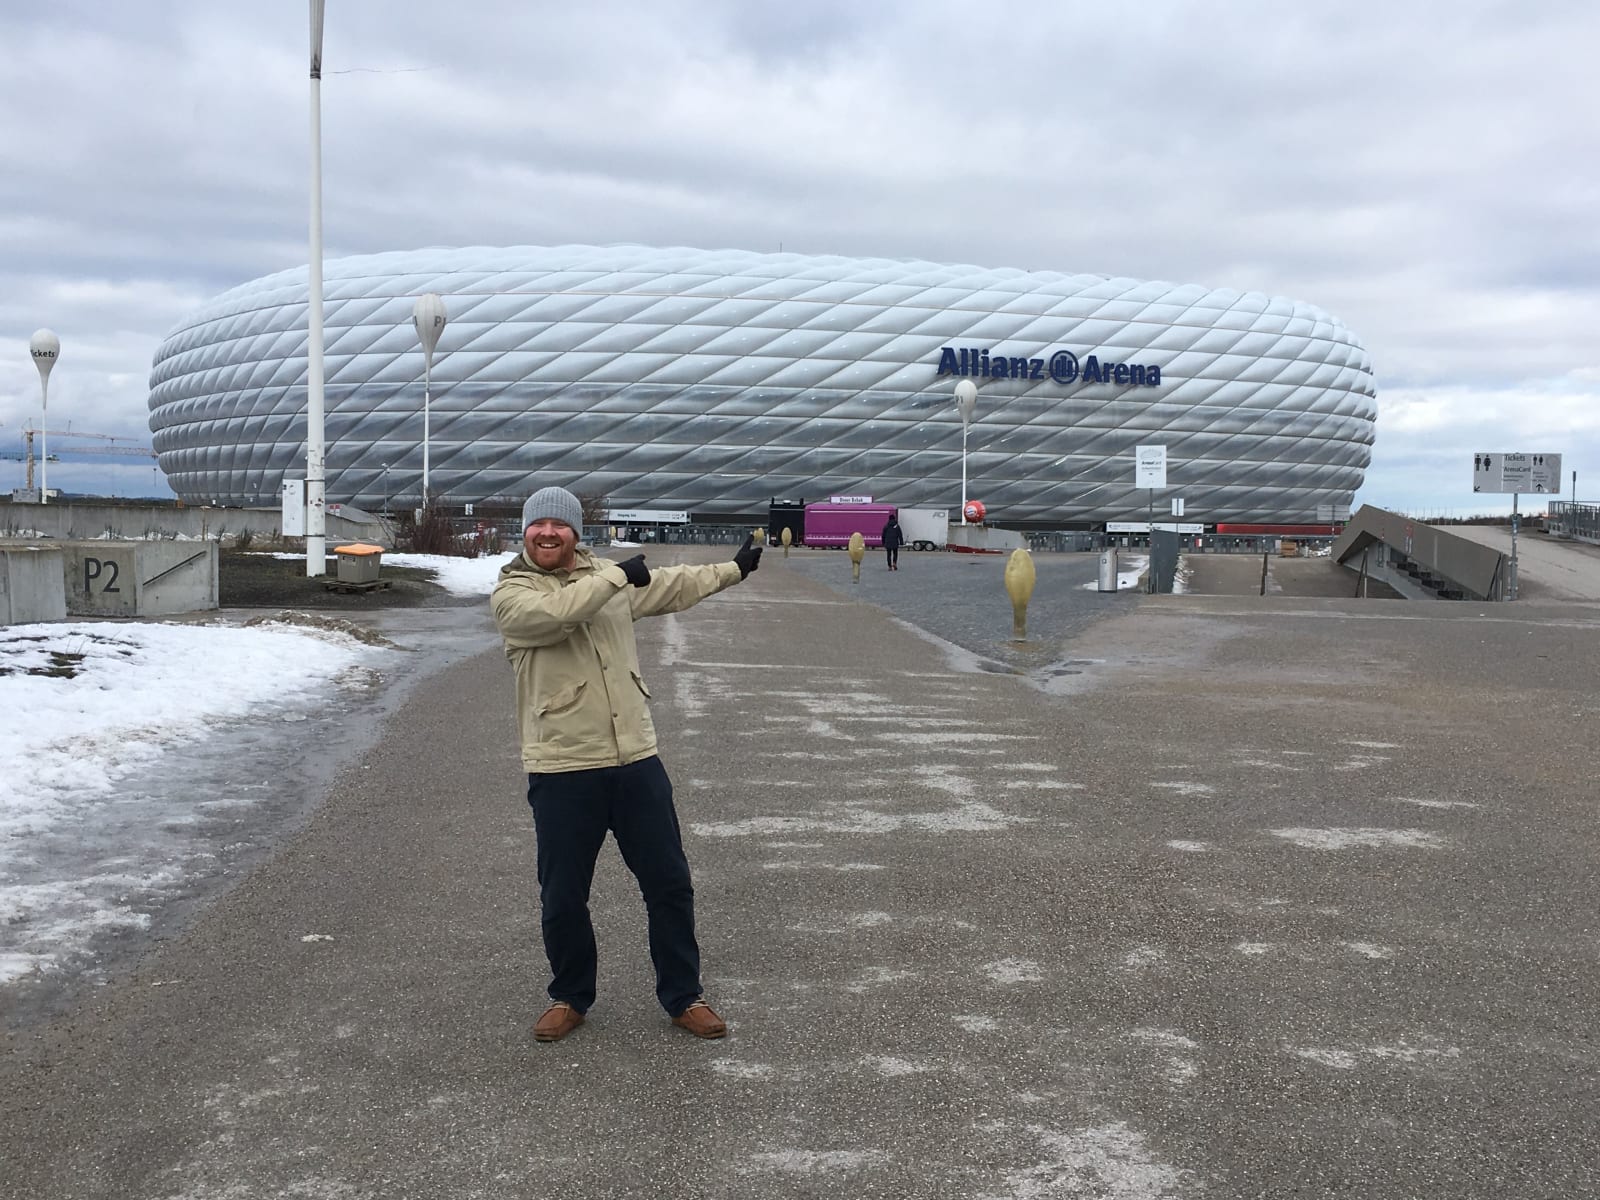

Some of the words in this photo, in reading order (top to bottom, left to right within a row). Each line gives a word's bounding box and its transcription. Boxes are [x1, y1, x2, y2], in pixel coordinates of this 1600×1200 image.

[937, 347, 1045, 380] Allianz
[1082, 355, 1161, 386] Arena
[84, 557, 121, 593] P2
